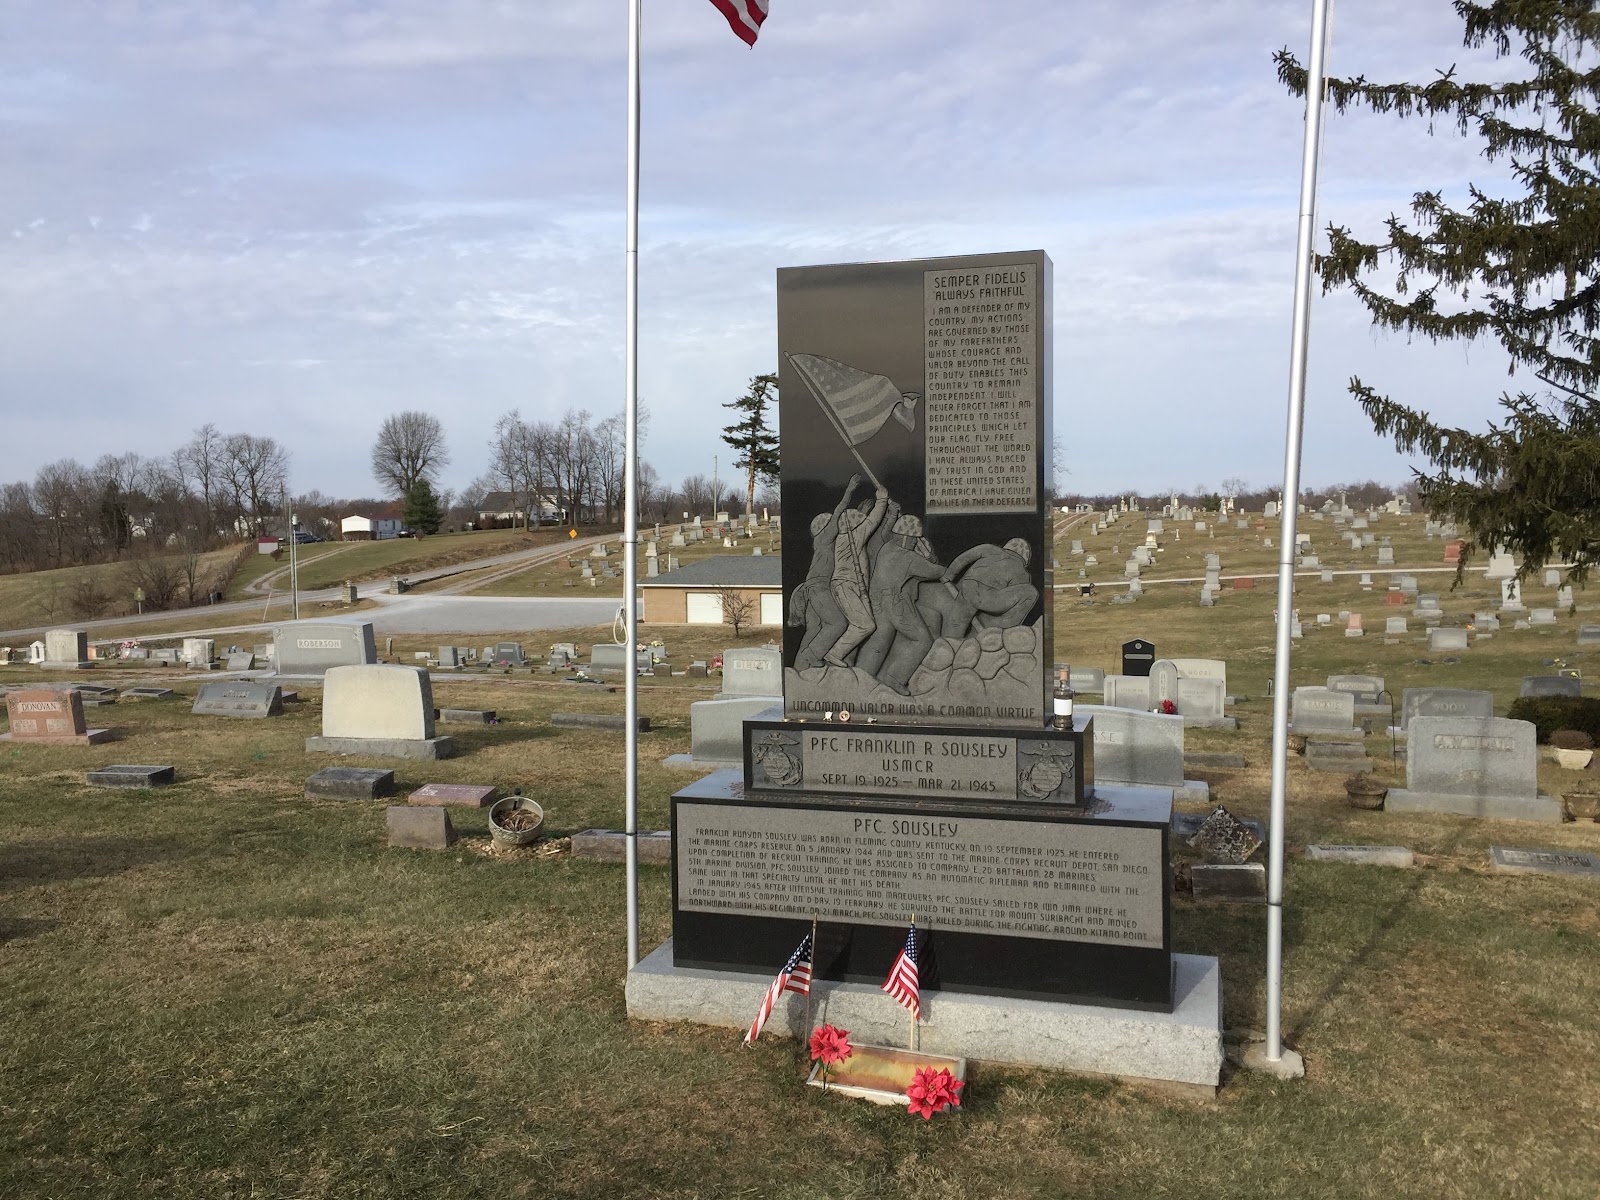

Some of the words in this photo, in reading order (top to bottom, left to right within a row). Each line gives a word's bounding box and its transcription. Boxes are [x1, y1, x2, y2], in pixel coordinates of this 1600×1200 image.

[934, 274, 979, 289] SEMPER
[985, 271, 1026, 285] FIDELIS
[939, 307, 950, 316] AM
[962, 304, 1001, 314] DEFENDER
[1005, 303, 1014, 311] OF
[988, 313, 1022, 323] ACTIONS
[929, 329, 943, 338] ARE
[946, 326, 987, 337] GOVERNED
[991, 326, 1001, 334] BY
[1005, 324, 1029, 333] THOSE
[961, 335, 1017, 346] FOREFATHERS
[929, 350, 956, 359] WHOSE
[962, 348, 1000, 357] COURAGE
[1006, 346, 1021, 354] AND
[929, 361, 953, 370] VALOR
[958, 359, 988, 368] BEYOND
[993, 358, 1006, 366] THE
[1011, 357, 1030, 365] CALL
[943, 371, 963, 380] DUTY
[969, 369, 1004, 378] ENABLES
[1009, 368, 1028, 376] THIS
[929, 382, 968, 391] COUNTRY
[988, 379, 1021, 388] REMAIN
[998, 390, 1016, 398] WILL
[930, 404, 953, 412] NEVER
[957, 402, 986, 411] FORGET
[990, 401, 1008, 410] THAT
[1019, 400, 1031, 408] AM
[930, 414, 974, 423] DEDICATED
[993, 412, 1019, 420] THOSE
[929, 424, 976, 433] PRINCIPLES
[982, 423, 1008, 431] WHICH
[951, 435, 969, 443] FLAG
[995, 433, 1014, 441] FREE
[930, 446, 980, 455] THROUGHOUT
[936, 457, 955, 465] HAVE
[960, 455, 991, 464] ALWAYS
[996, 454, 1025, 463] PLACED
[967, 477, 994, 485] UNITED
[997, 476, 1024, 484] STATES
[972, 498, 993, 507] THEIR
[298, 640, 340, 648] ROBERSON
[22, 702, 57, 711] DONOVAN
[793, 701, 854, 712] UNCOMMON
[860, 703, 894, 714] VALOR
[900, 704, 922, 714] WAS
[940, 705, 991, 717] COMMON
[997, 707, 1036, 718] VIRTUE
[847, 739, 915, 755] FRANKLIN
[942, 742, 1008, 758] SOUSLEY
[882, 759, 933, 773] USMCR
[874, 776, 898, 788] 1925
[969, 780, 996, 793] 1945
[855, 818, 886, 834] PFC.
[892, 820, 958, 838] SOUSLEY
[696, 828, 729, 837] FRANKLIN
[733, 831, 762, 839] RUNYON
[766, 833, 796, 841] SOUSLEY
[856, 838, 886, 846] FLEMING
[996, 846, 1042, 856] SEPTEMBER
[1084, 851, 1119, 861] ENTERED
[689, 848, 707, 856] UPON
[711, 849, 755, 859] COMPLETION
[772, 853, 801, 862] RECRUIT
[856, 859, 871, 867] WAS
[877, 860, 913, 869] ASSIGNED
[931, 863, 968, 873] COMPANY
[704, 839, 730, 847] MARINE
[734, 841, 758, 849] CORPS
[761, 842, 792, 851] RESERVE
[817, 846, 851, 855] JANUARY
[855, 848, 872, 856] 1944
[877, 849, 892, 858] AND
[897, 851, 912, 859] WAS
[917, 852, 934, 860] SENT
[952, 854, 965, 862] THE
[970, 855, 1000, 864] MARINE
[1004, 857, 1030, 866] CORPS
[1034, 859, 1068, 868] RECRUIT
[1102, 863, 1118, 872] SAN
[705, 859, 731, 868] MARINE
[788, 865, 819, 874] SOUSLEY
[824, 867, 849, 876] JOINED
[870, 870, 907, 880] COMPANY
[941, 875, 985, 885] AUTOMATIC
[990, 878, 1028, 888] RIFLEMAN
[1033, 881, 1049, 889] AND
[1054, 882, 1096, 892] REMAINED
[762, 873, 800, 883] SPECIALTY
[842, 878, 856, 887] MET
[861, 880, 872, 888] HIS
[708, 880, 740, 889] JANUARY
[765, 883, 786, 892] AFTER
[790, 885, 826, 895] INTENSIVE
[830, 888, 863, 897] TRAINING
[867, 891, 882, 899] AND
[955, 897, 988, 906] SOUSLEY
[993, 899, 1020, 909] SAILED
[1024, 902, 1038, 910] FOR
[1085, 906, 1113, 915] WHERE
[754, 893, 789, 902] COMPANY
[901, 903, 938, 913] SURVIVED
[960, 908, 986, 917] BATTLE
[991, 910, 1005, 918] FOR
[1009, 911, 1036, 920] MOUNT
[1040, 913, 1083, 924] SURIBACHI
[1108, 918, 1137, 928] MOVED
[936, 917, 961, 926] KILLED
[965, 919, 994, 928] DURING
[1055, 926, 1088, 935] AROUND
[1091, 928, 1120, 938] KITANO
